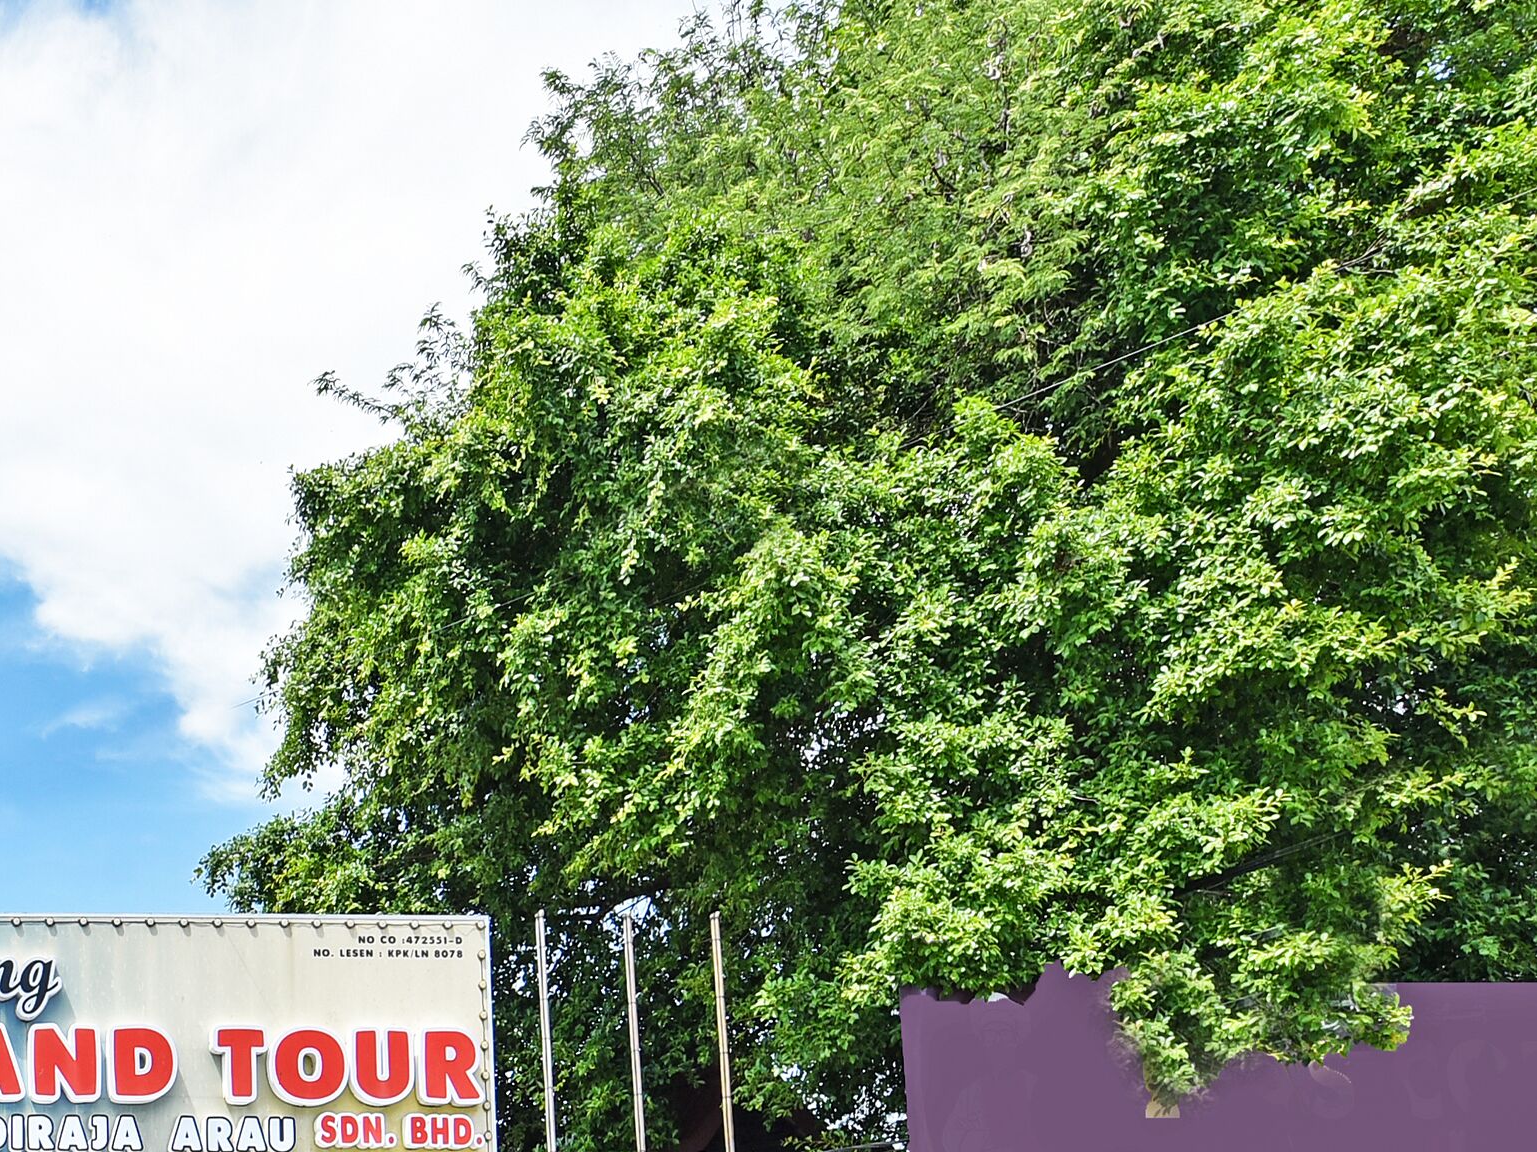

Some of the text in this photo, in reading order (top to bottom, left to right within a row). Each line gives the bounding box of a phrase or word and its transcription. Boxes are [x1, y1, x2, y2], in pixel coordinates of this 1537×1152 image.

[358, 936, 374, 944] NO
[380, 936, 396, 944] CO
[313, 949, 333, 957] NO.
[340, 950, 373, 958] LESEN
[388, 950, 429, 958] KPK/LN
[434, 950, 463, 958] 8078
[217, 1027, 480, 1101] TOUR
[320, 1115, 395, 1146] SDN.
[411, 1115, 483, 1146] BHD.
